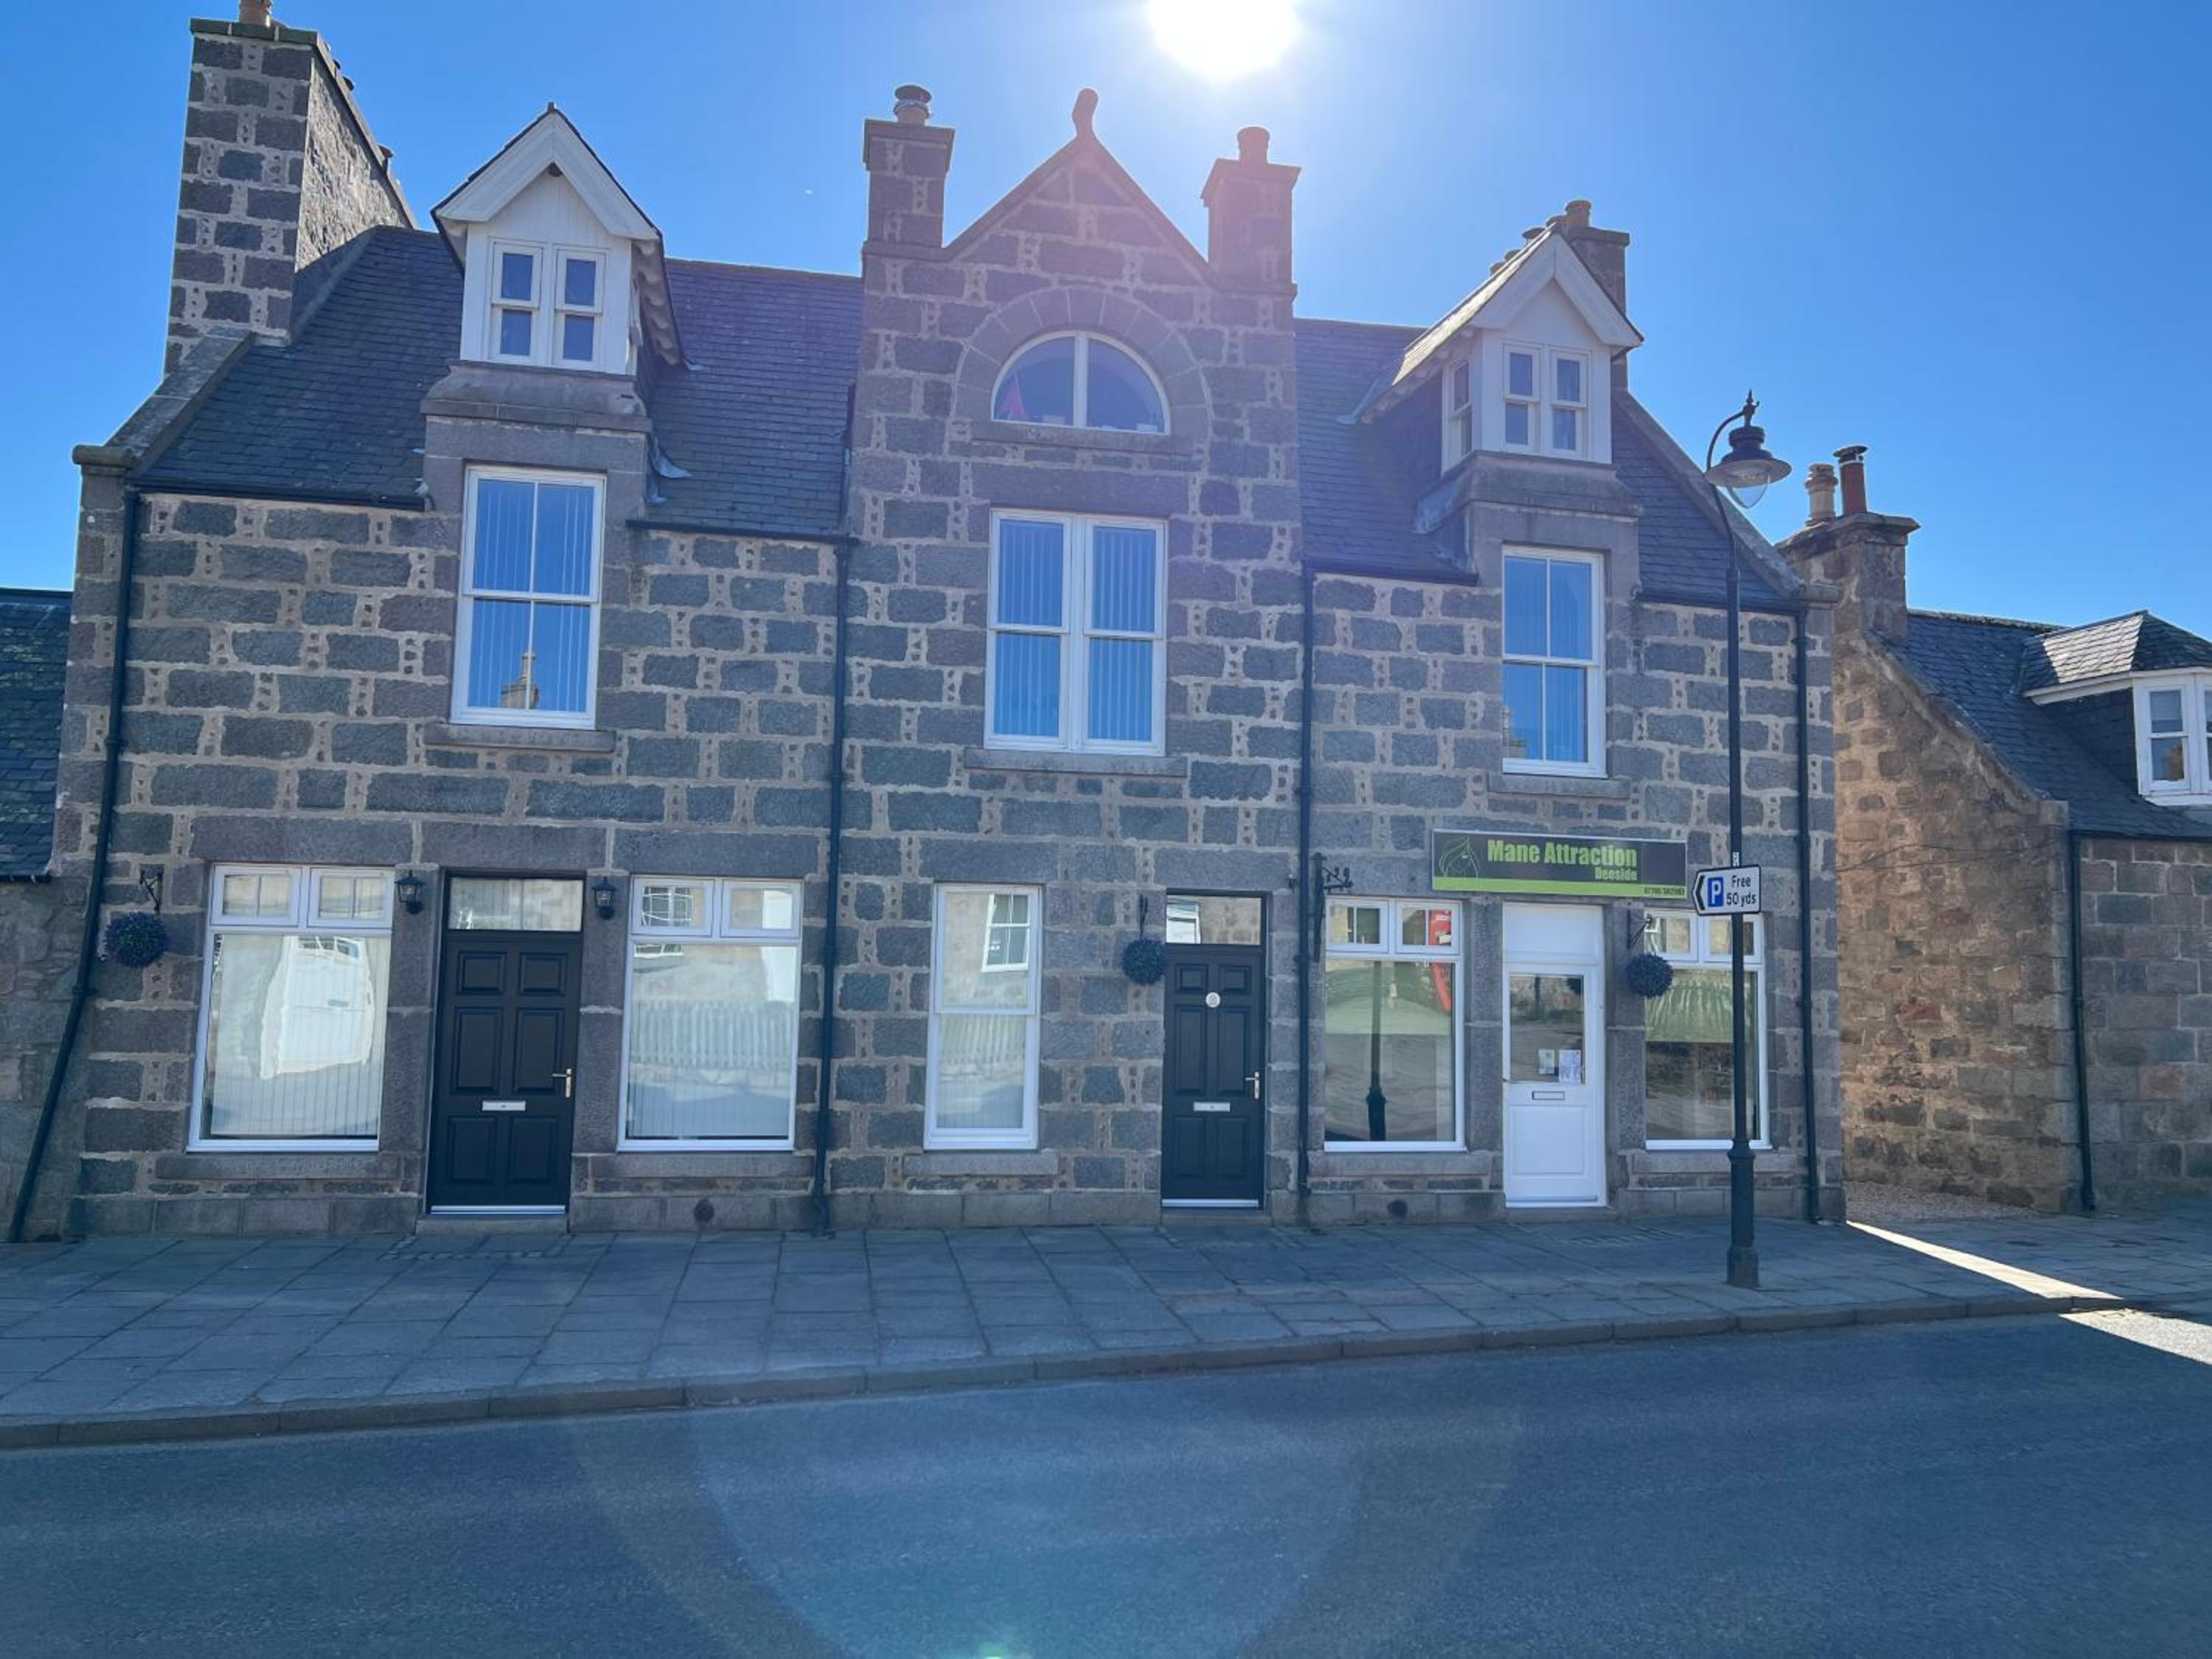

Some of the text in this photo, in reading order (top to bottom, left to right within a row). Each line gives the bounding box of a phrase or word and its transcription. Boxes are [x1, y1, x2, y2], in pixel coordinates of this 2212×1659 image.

[1487, 839, 1638, 867] Mane Attraction
[1595, 866, 1638, 881] Deeside
[1731, 874, 1751, 888] Free
[1711, 880, 1722, 905] P
[1726, 891, 1757, 908] 50 yds
